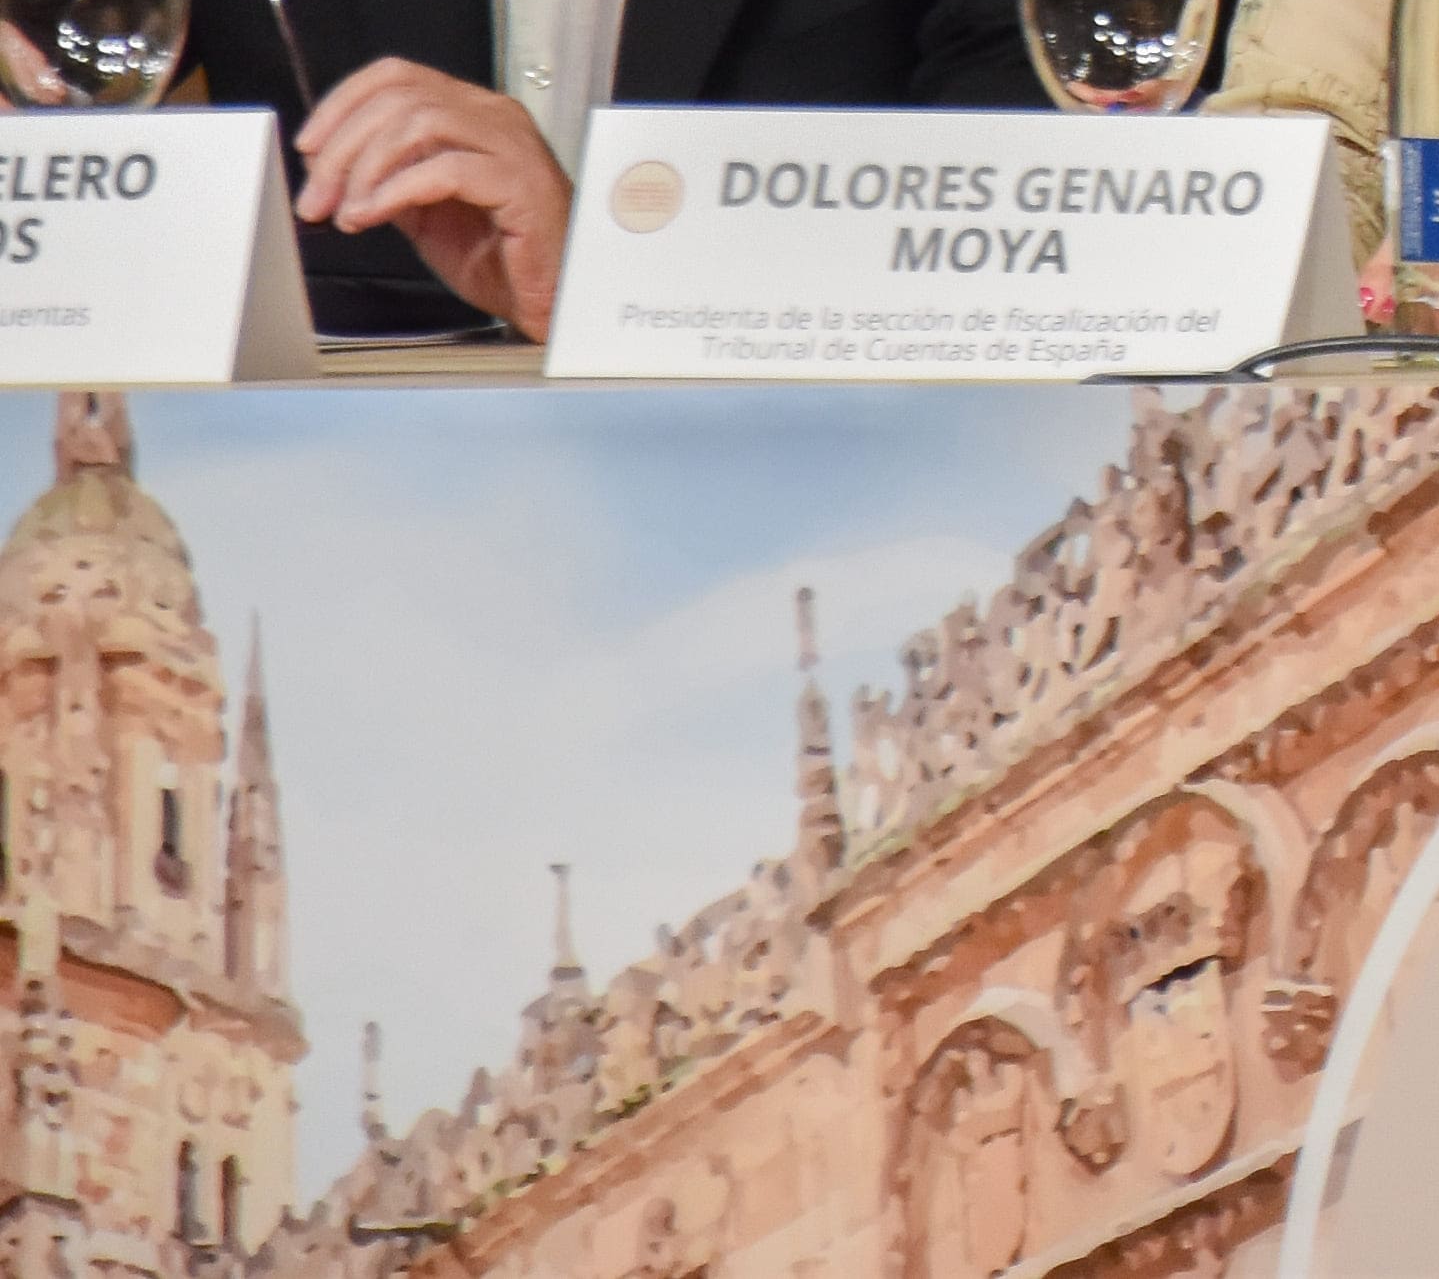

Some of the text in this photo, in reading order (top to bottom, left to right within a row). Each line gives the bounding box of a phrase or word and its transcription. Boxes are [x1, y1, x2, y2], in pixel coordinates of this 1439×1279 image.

[719, 160, 999, 214] DOLORES
[1015, 166, 1264, 217] GENARO
[890, 227, 1068, 275] MOYA
[620, 304, 1221, 333] Presidenta de la sección de fiscalización del
[702, 335, 1127, 369] Tribunal de Cuentas de España
